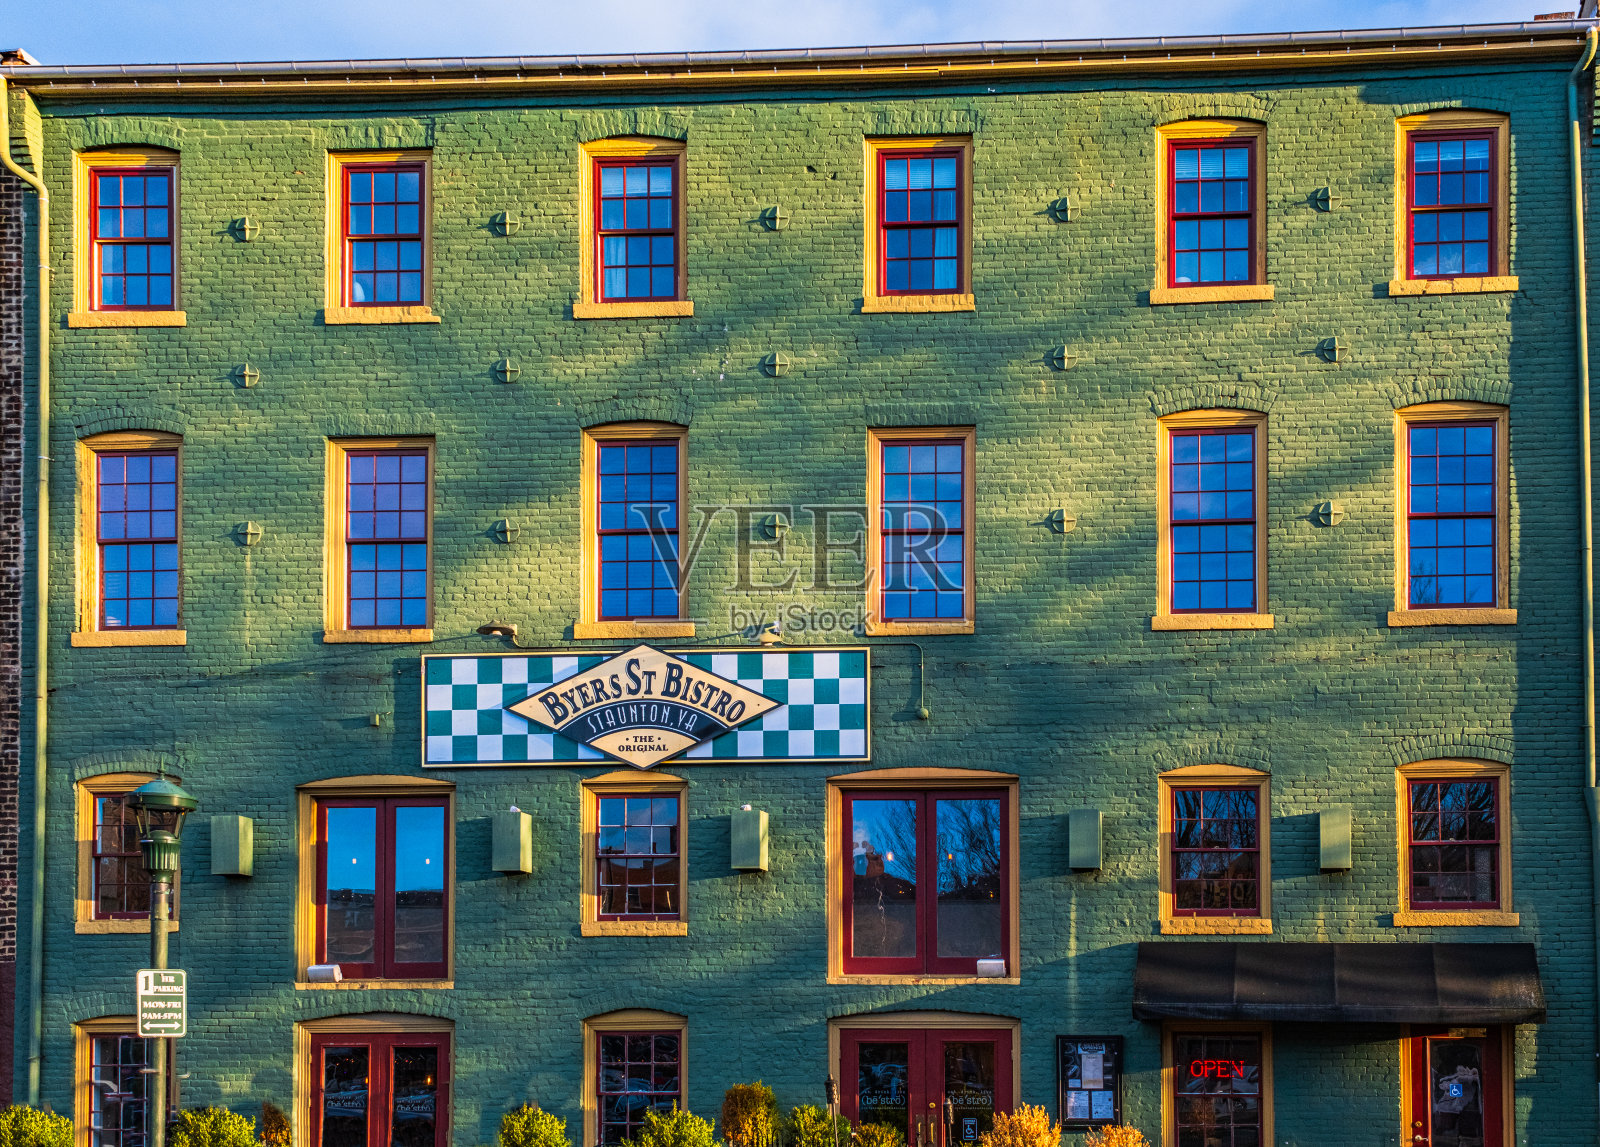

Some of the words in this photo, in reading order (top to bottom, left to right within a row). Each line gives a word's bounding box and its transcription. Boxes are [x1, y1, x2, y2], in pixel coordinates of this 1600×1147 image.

[537, 674, 623, 726] BYERS
[660, 662, 747, 723] BISTRO
[633, 735, 655, 743] THE
[617, 743, 669, 752] ORIGINAL
[144, 975, 150, 991] 1
[153, 985, 184, 993] PARKING
[142, 1001, 182, 1009] MON-FRI
[1190, 1059, 1245, 1078] OPEN
